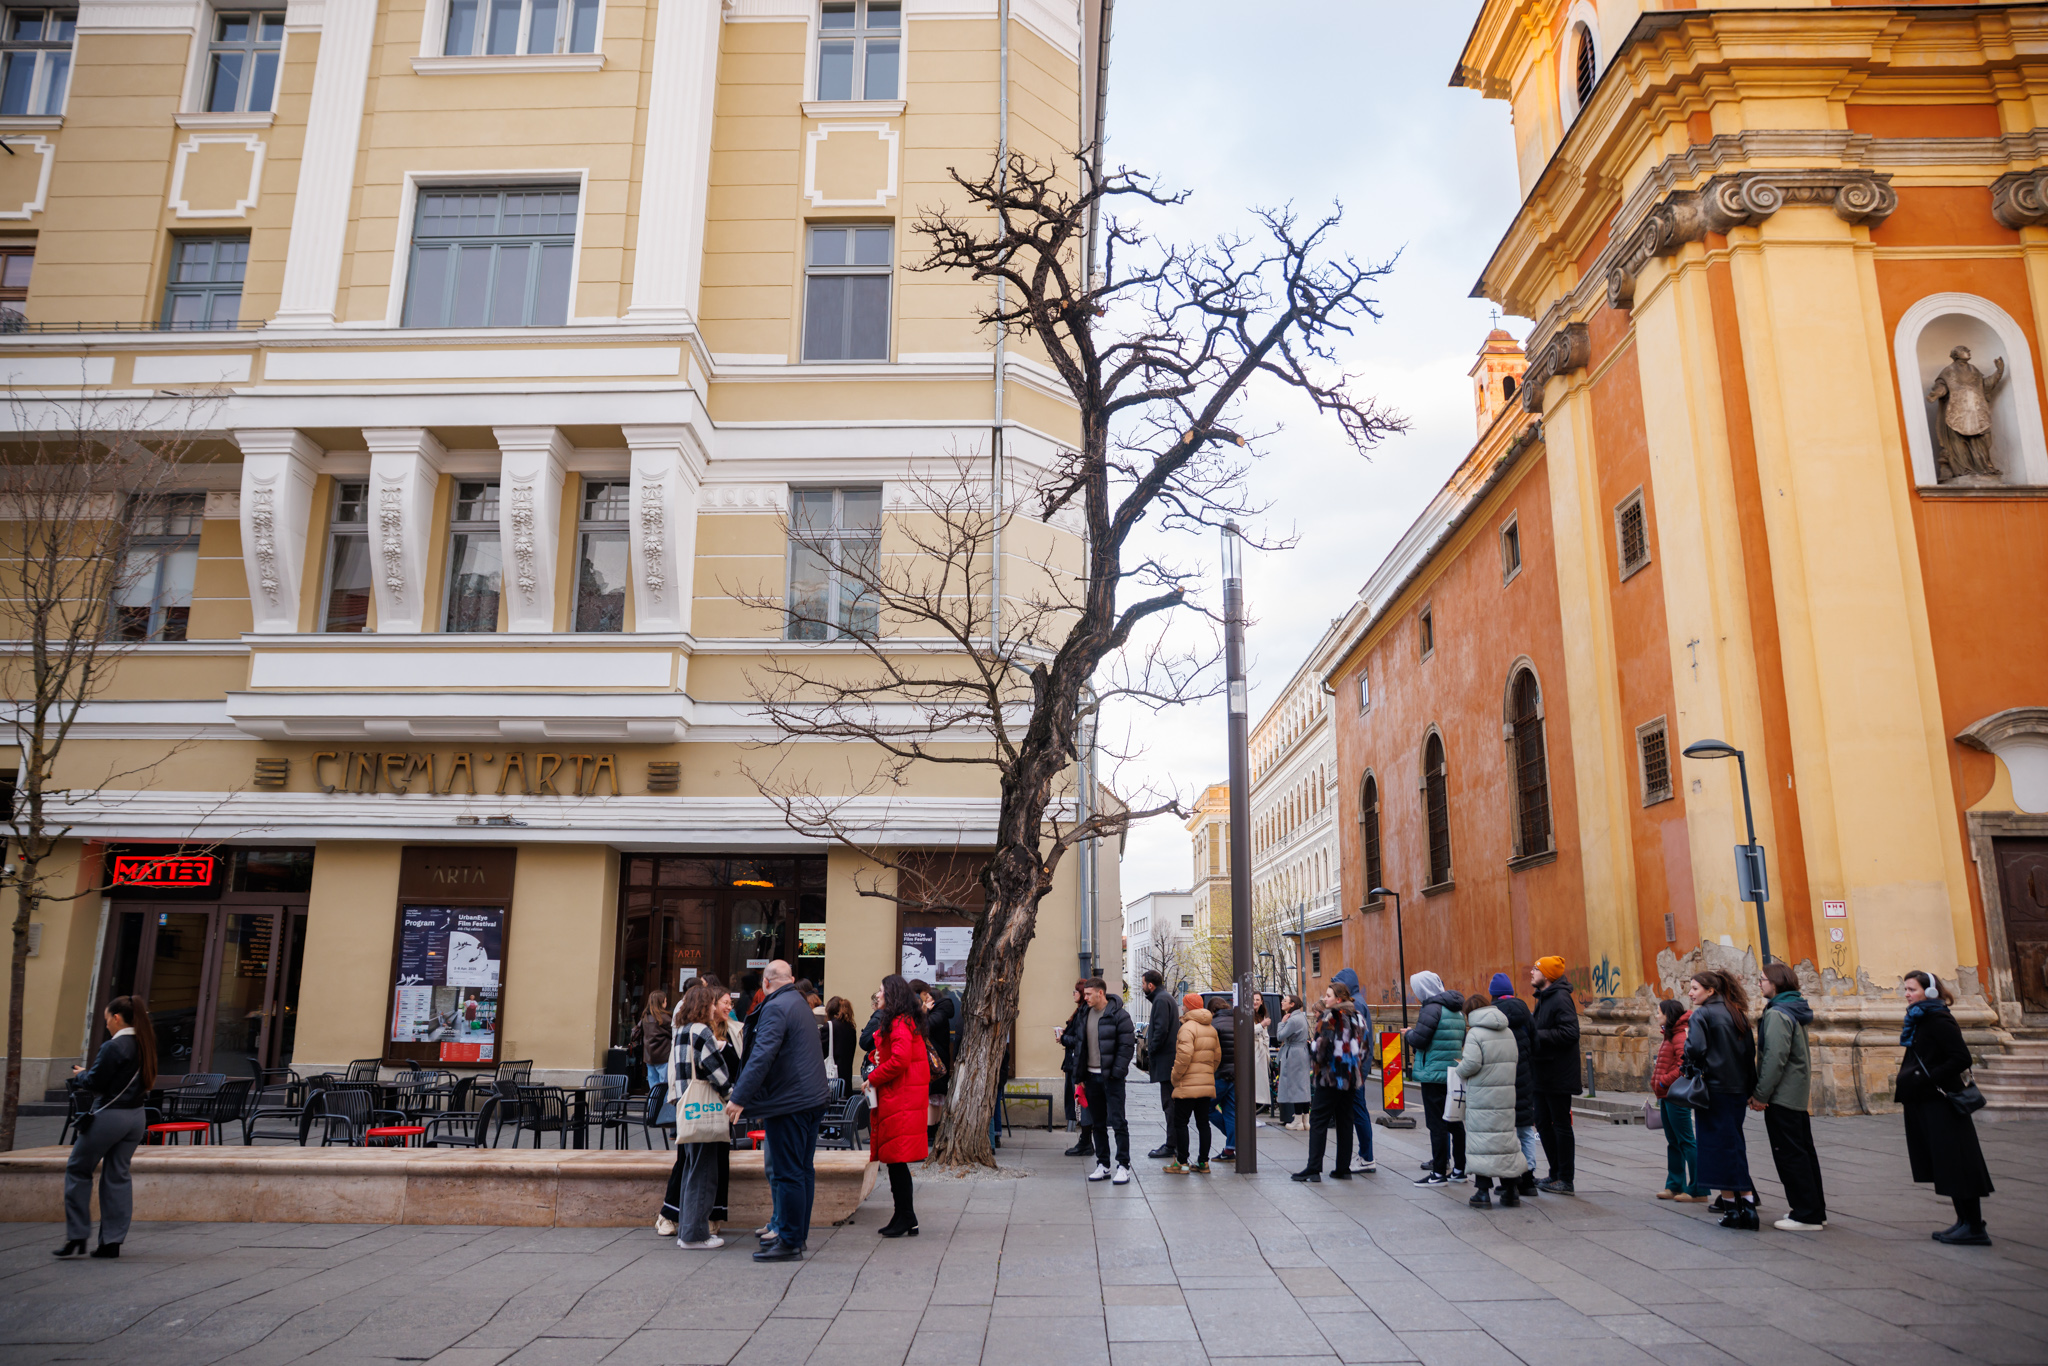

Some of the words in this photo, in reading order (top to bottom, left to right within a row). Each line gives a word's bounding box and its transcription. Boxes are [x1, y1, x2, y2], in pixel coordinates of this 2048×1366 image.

[311, 751, 477, 795] CINEMA
[495, 752, 621, 796] ARTA
[119, 862, 207, 880] MATTER
[458, 914, 488, 922] UrbanEye
[404, 919, 435, 928] Program
[702, 1103, 723, 1113] CSD
